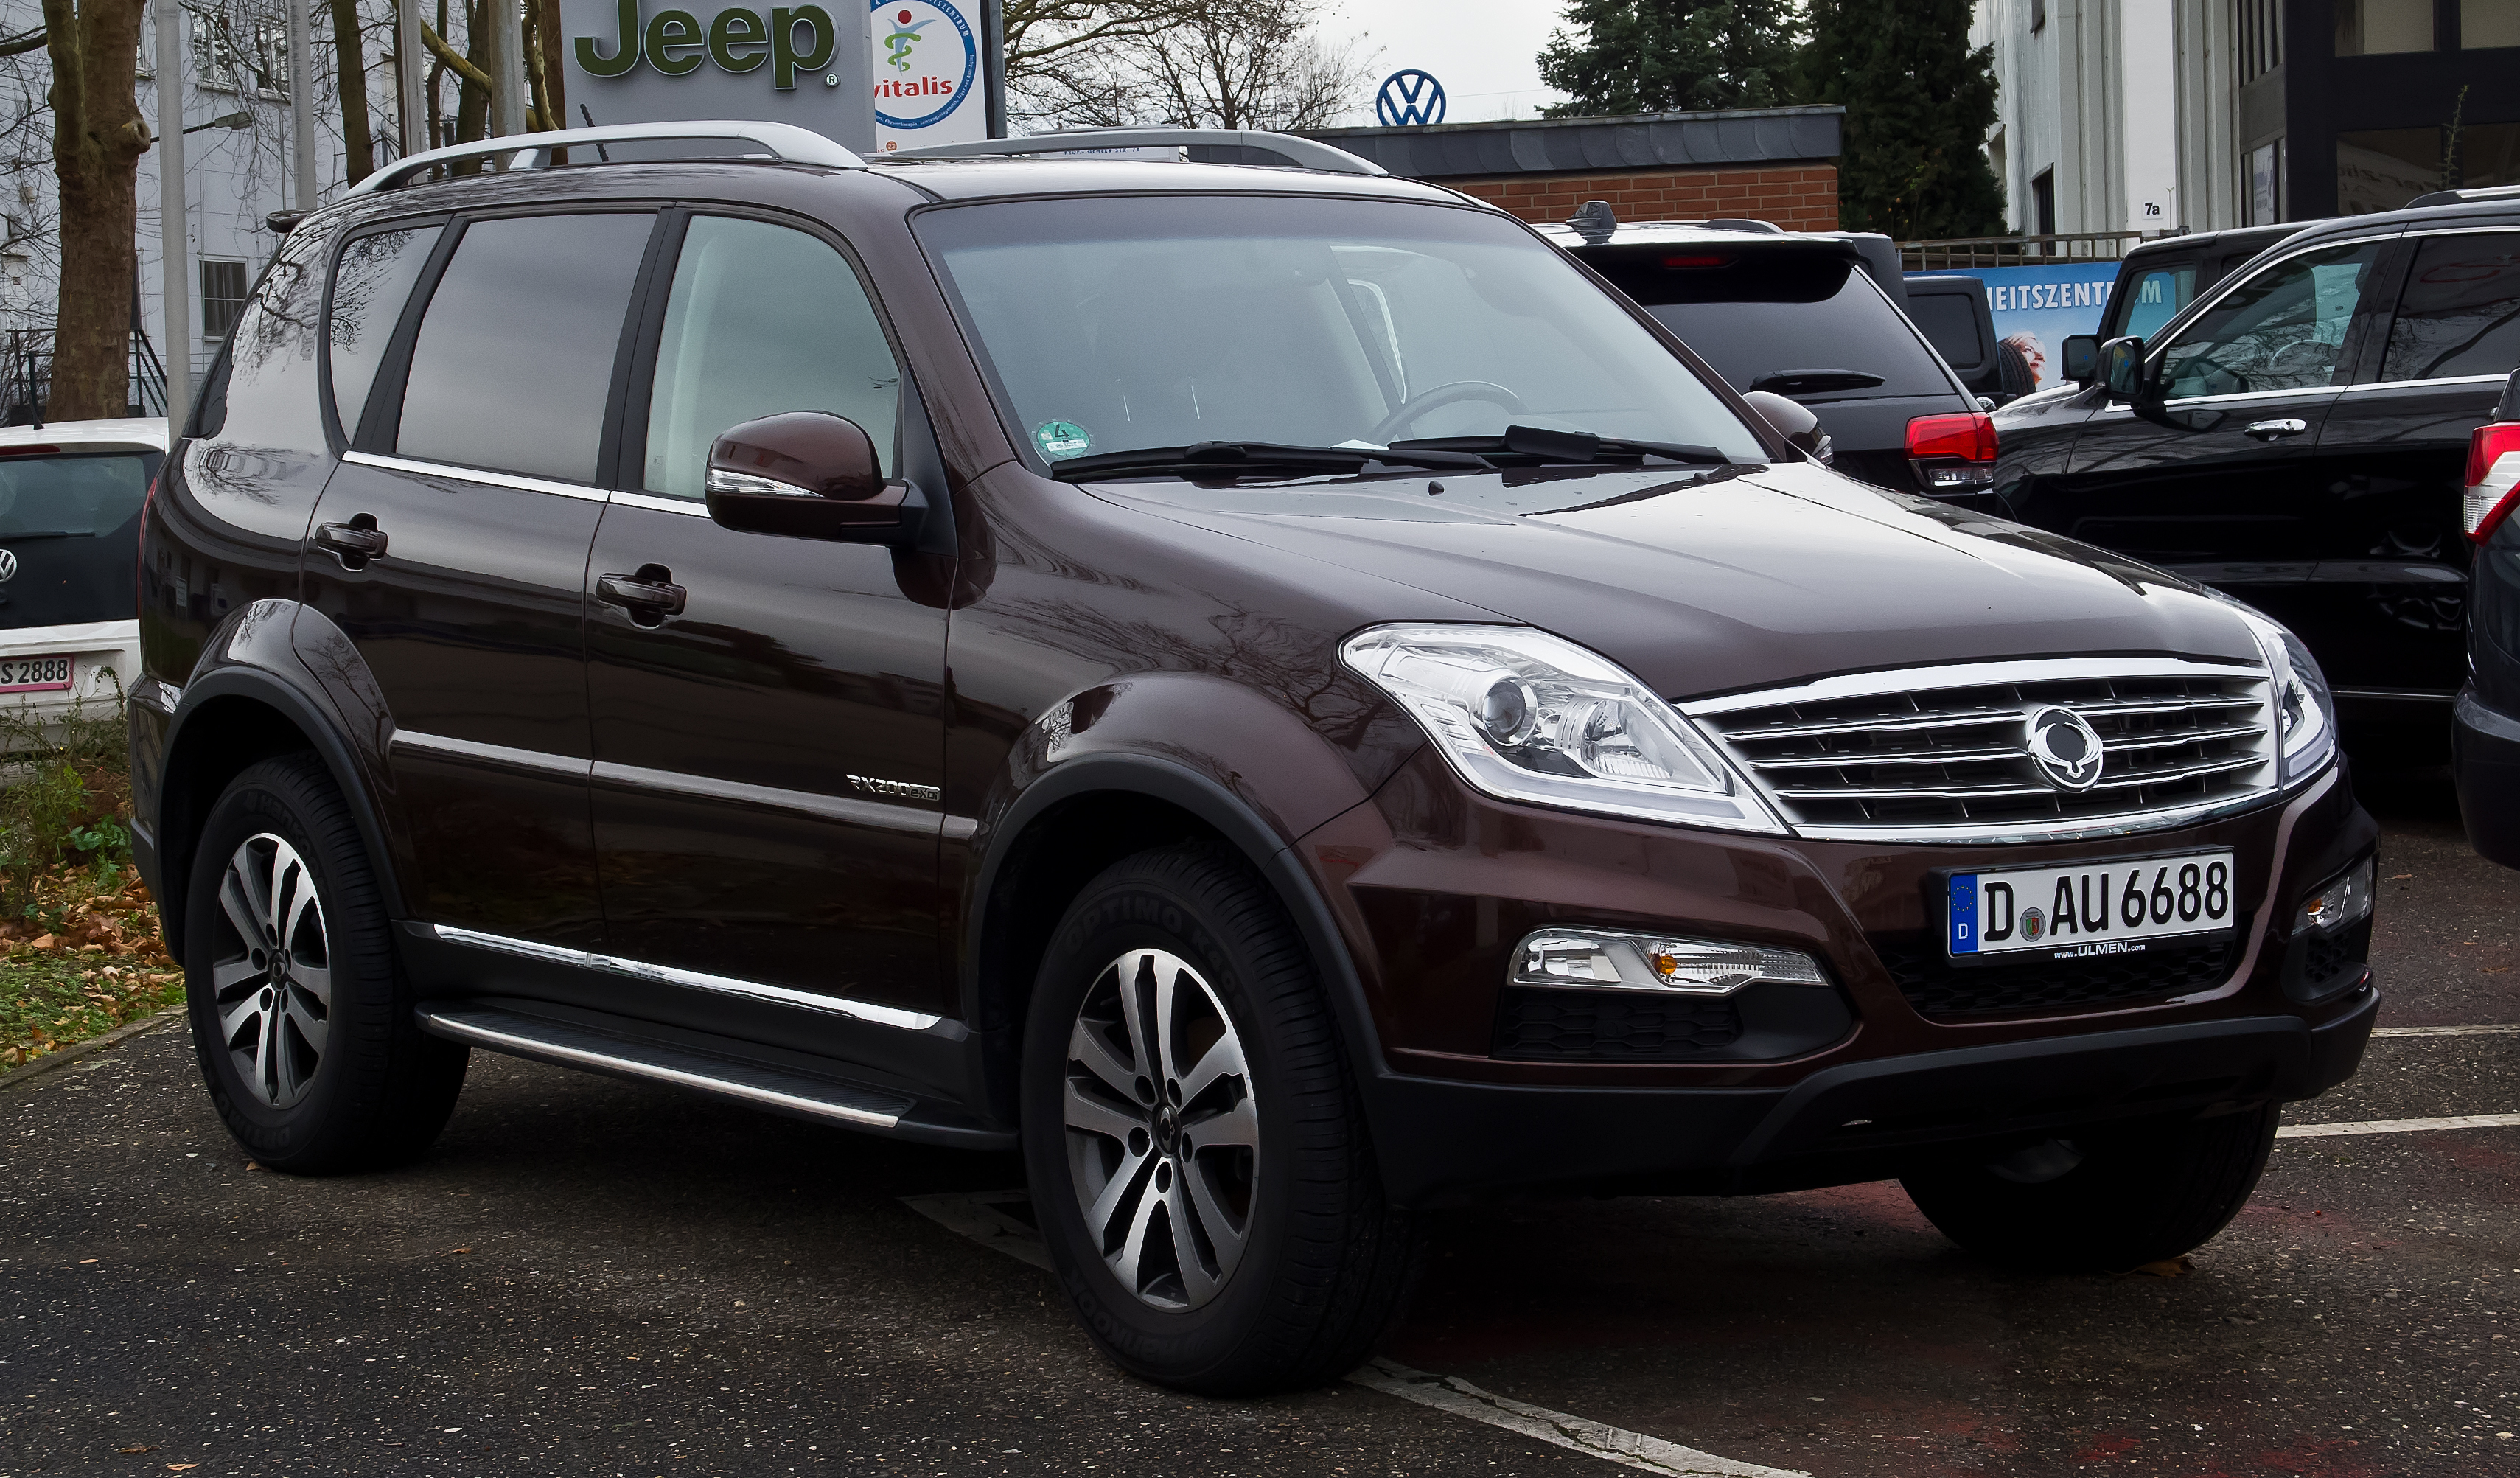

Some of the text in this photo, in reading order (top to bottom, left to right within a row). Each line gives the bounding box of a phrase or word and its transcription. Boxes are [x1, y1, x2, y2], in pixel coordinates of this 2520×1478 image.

[574, 0, 838, 90] Jeep
[2144, 202, 2160, 215] 7a
[1055, 424, 1069, 438] 4
[18, 660, 68, 683] 2888
[1984, 860, 2229, 941] D AU 6688
[1958, 922, 1969, 940] D
[2053, 941, 2146, 959] www.ULMEN.com
